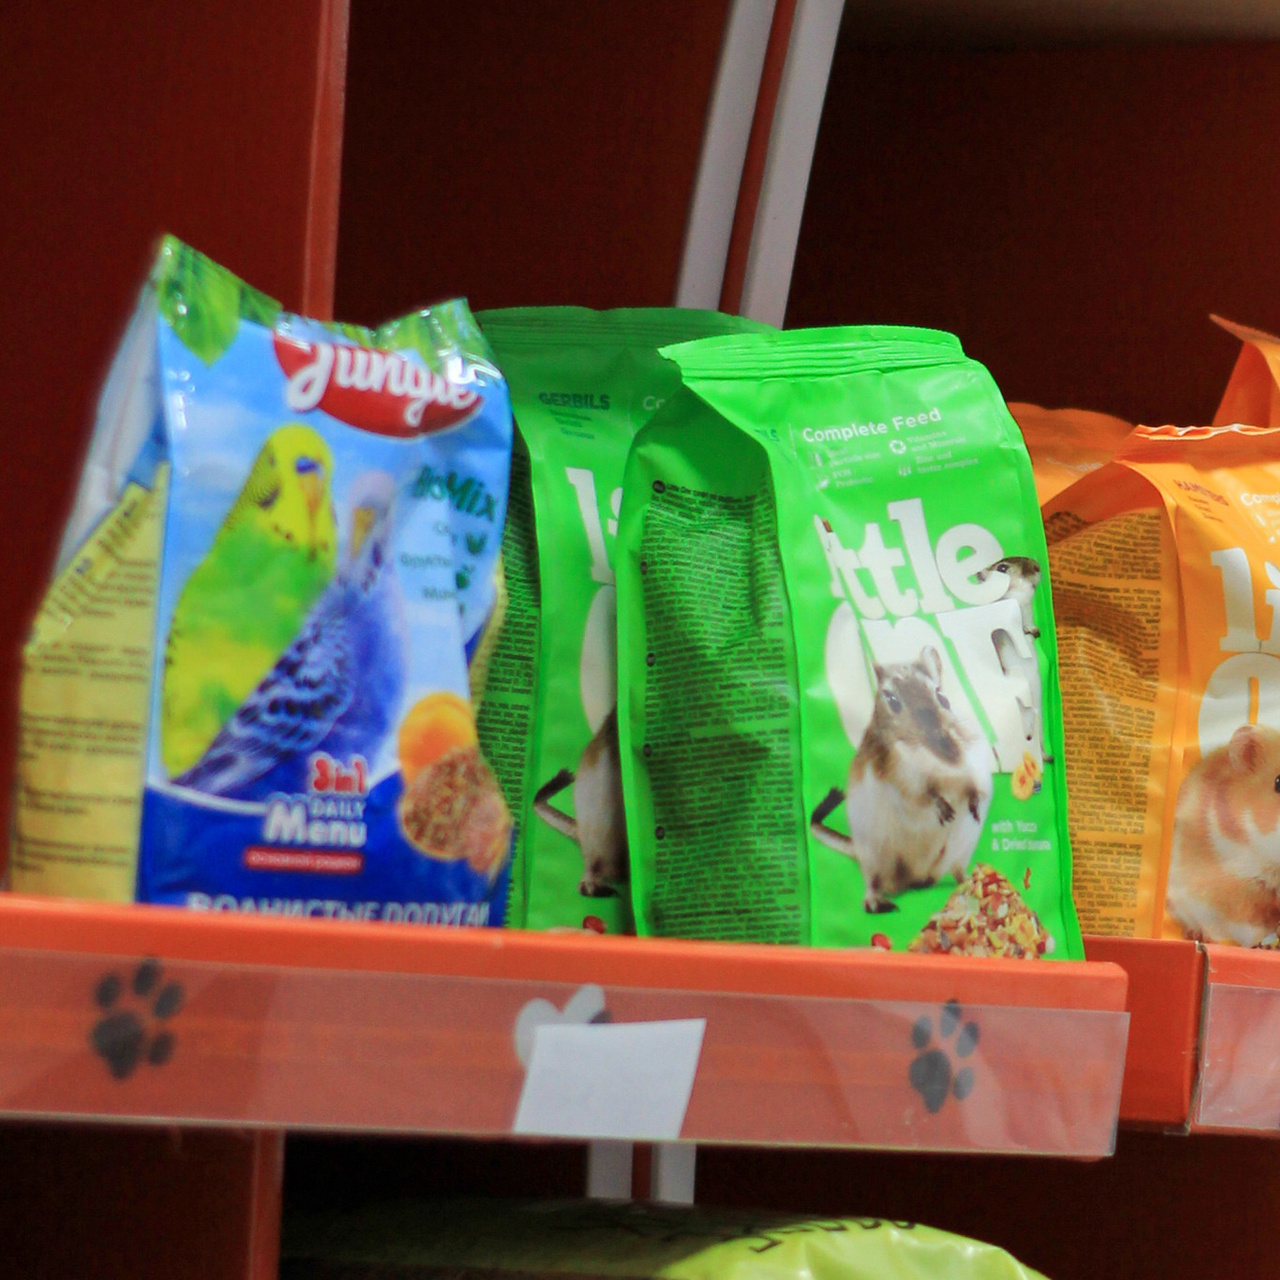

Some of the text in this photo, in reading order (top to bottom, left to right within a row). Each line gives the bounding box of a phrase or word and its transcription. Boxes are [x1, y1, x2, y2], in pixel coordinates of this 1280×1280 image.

[286, 341, 484, 427] Jungle
[539, 392, 611, 411] GERBILS
[802, 407, 943, 443] Complete Feed
[262, 798, 368, 848] Menu
[308, 796, 367, 819] DAILY
